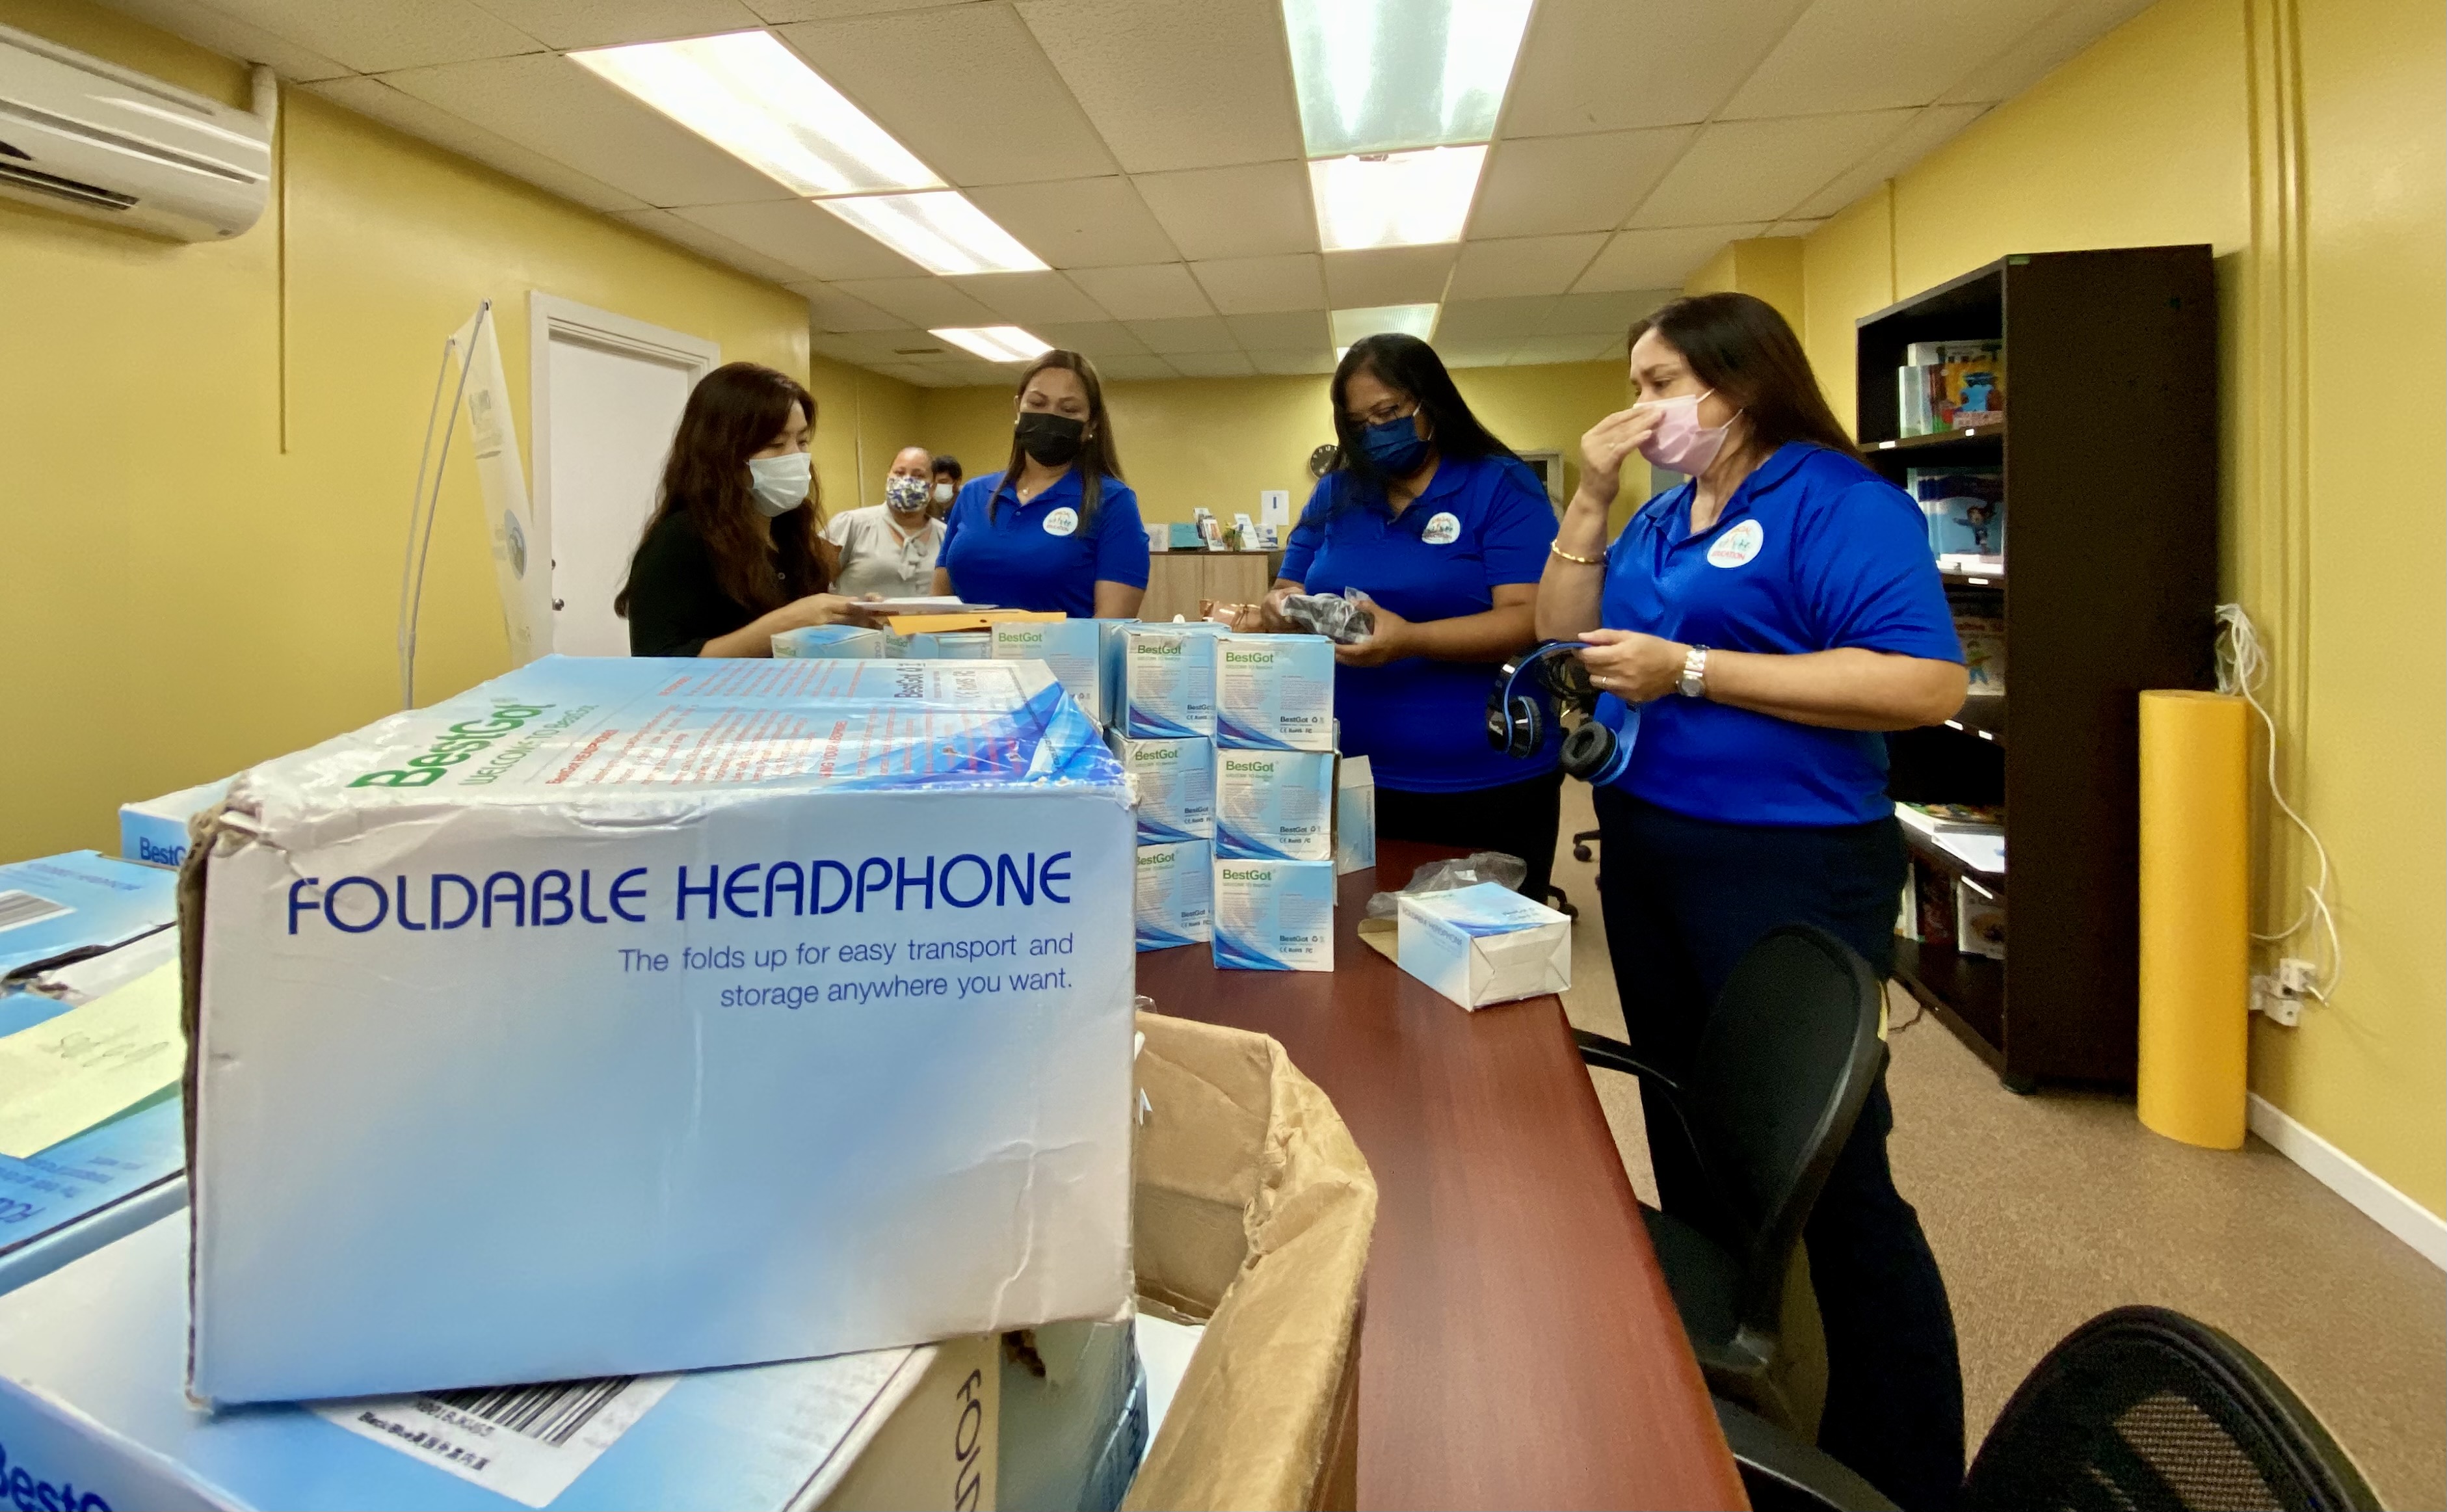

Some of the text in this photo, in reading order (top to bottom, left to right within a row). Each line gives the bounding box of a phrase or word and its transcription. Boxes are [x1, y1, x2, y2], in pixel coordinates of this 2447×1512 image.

[999, 632, 1042, 642] BestGot
[1137, 644, 1182, 654] BestGot
[1226, 652, 1274, 663] BestGot
[345, 703, 557, 788] BestGot
[1135, 749, 1178, 761] BestGot
[458, 741, 535, 785] WELCOME
[1226, 761, 1274, 772] BestGot
[1223, 869, 1271, 881] BestGot
[288, 867, 648, 935] FOLDABLE
[675, 851, 1072, 921] HEADPHONE
[618, 933, 1074, 974] The folds up for easy transport and
[720, 968, 1073, 1010] storage anywhere you want.
